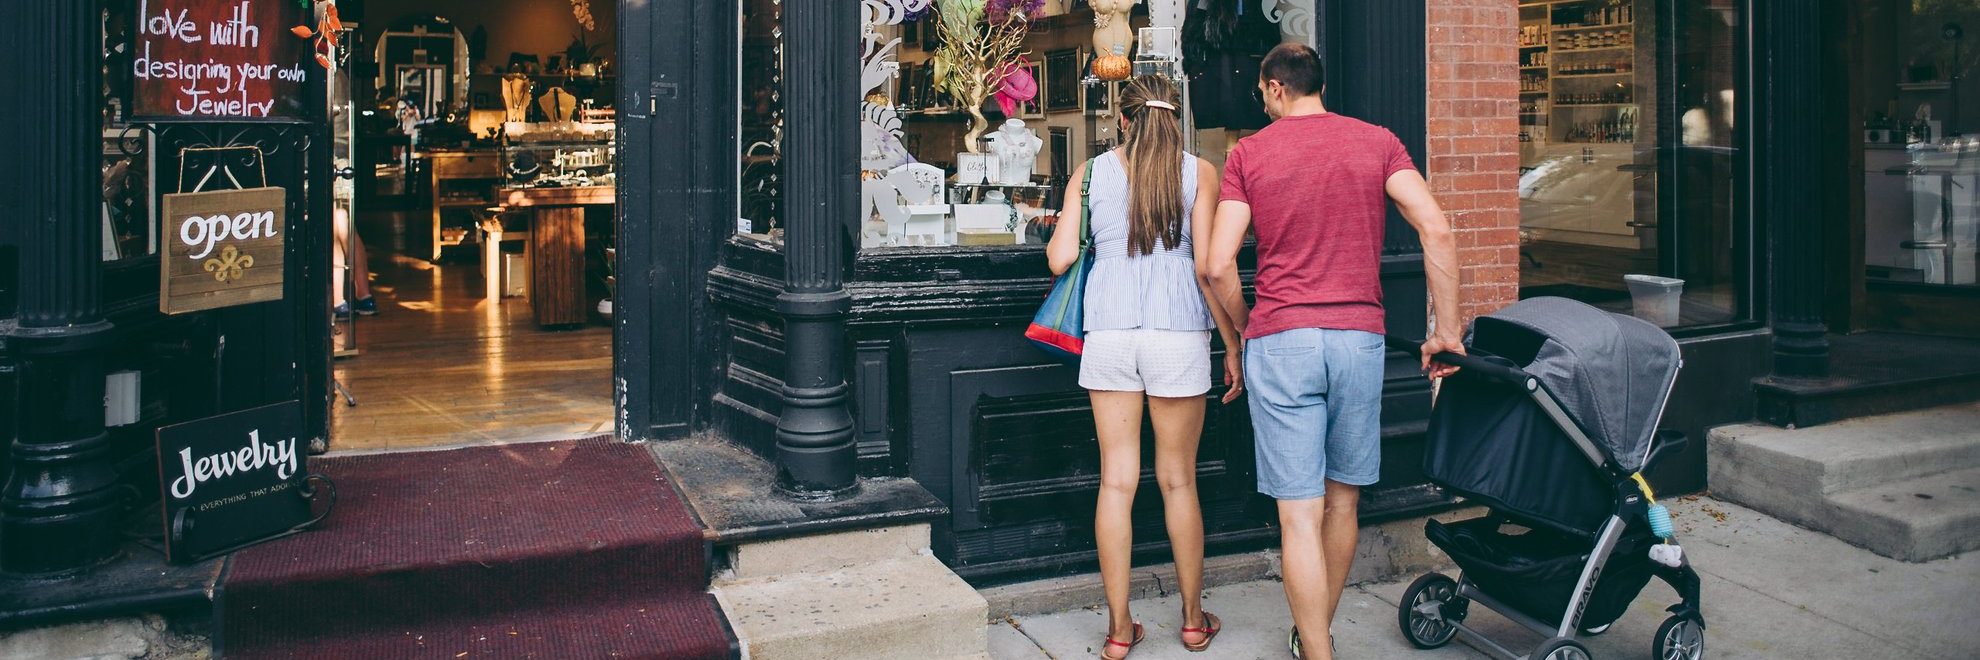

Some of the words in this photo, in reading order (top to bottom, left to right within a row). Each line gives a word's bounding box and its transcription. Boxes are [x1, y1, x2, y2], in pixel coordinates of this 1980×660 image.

[210, 1, 258, 47] with
[134, 41, 231, 94] designing
[237, 63, 277, 91] your
[278, 63, 305, 82] own
[176, 90, 274, 117] Jewelry
[180, 209, 278, 259] open
[171, 429, 297, 498] Jewelry
[200, 493, 247, 511] EVERYTHING
[250, 487, 267, 498] THAT
[1572, 567, 1599, 629] BRAVO
